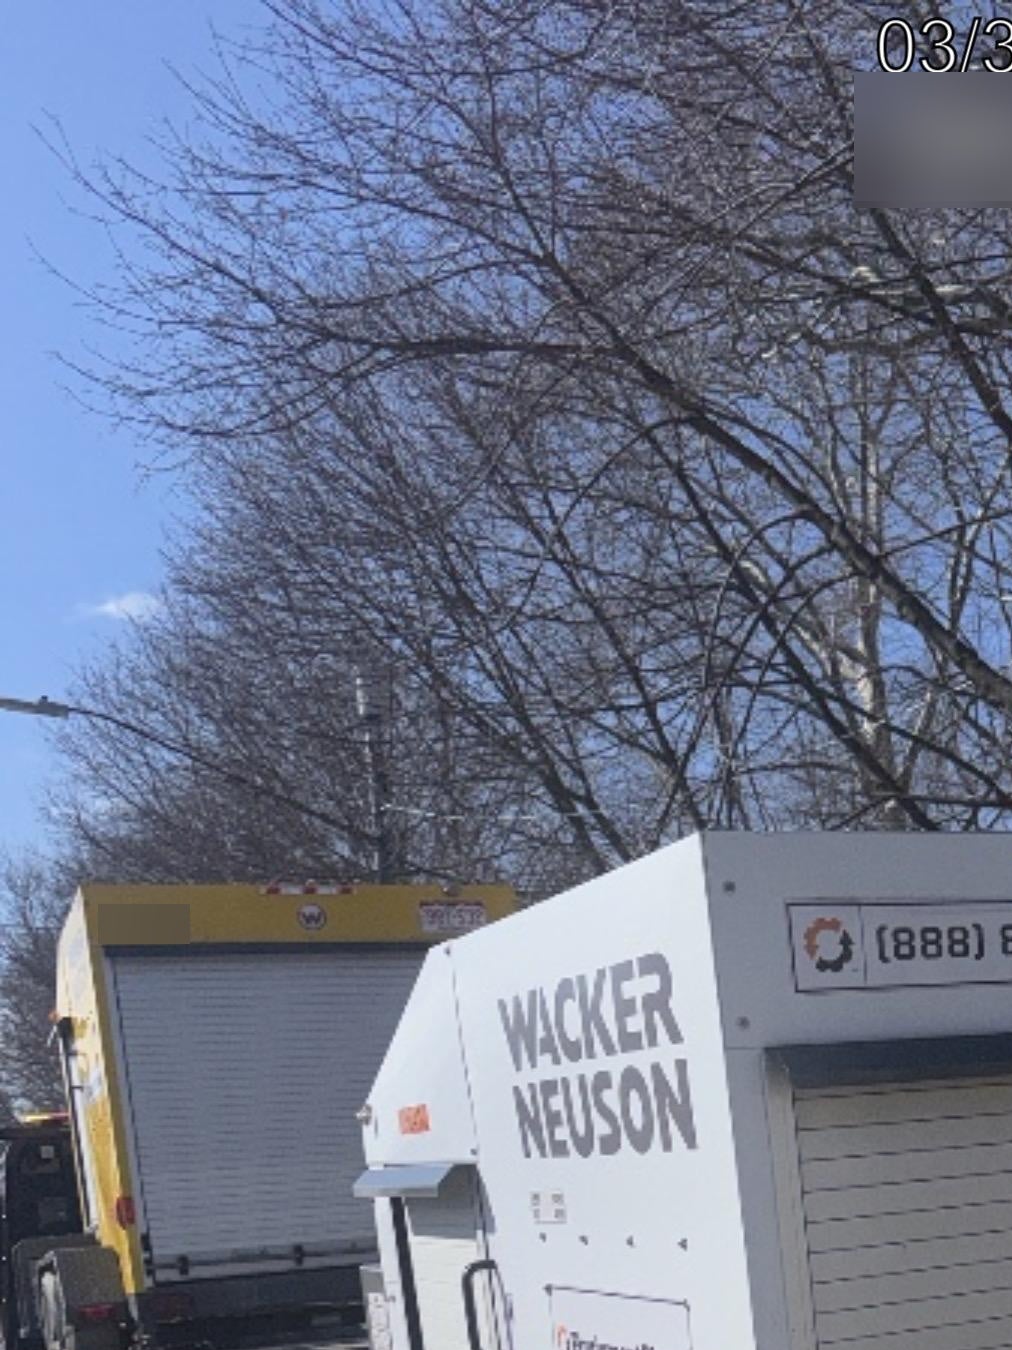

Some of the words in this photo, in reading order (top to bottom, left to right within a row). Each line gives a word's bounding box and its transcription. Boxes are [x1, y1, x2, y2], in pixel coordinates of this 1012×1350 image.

[875, 922, 987, 963] (888)
[496, 952, 684, 1073] WACKER
[511, 1058, 699, 1159] NEUSON
